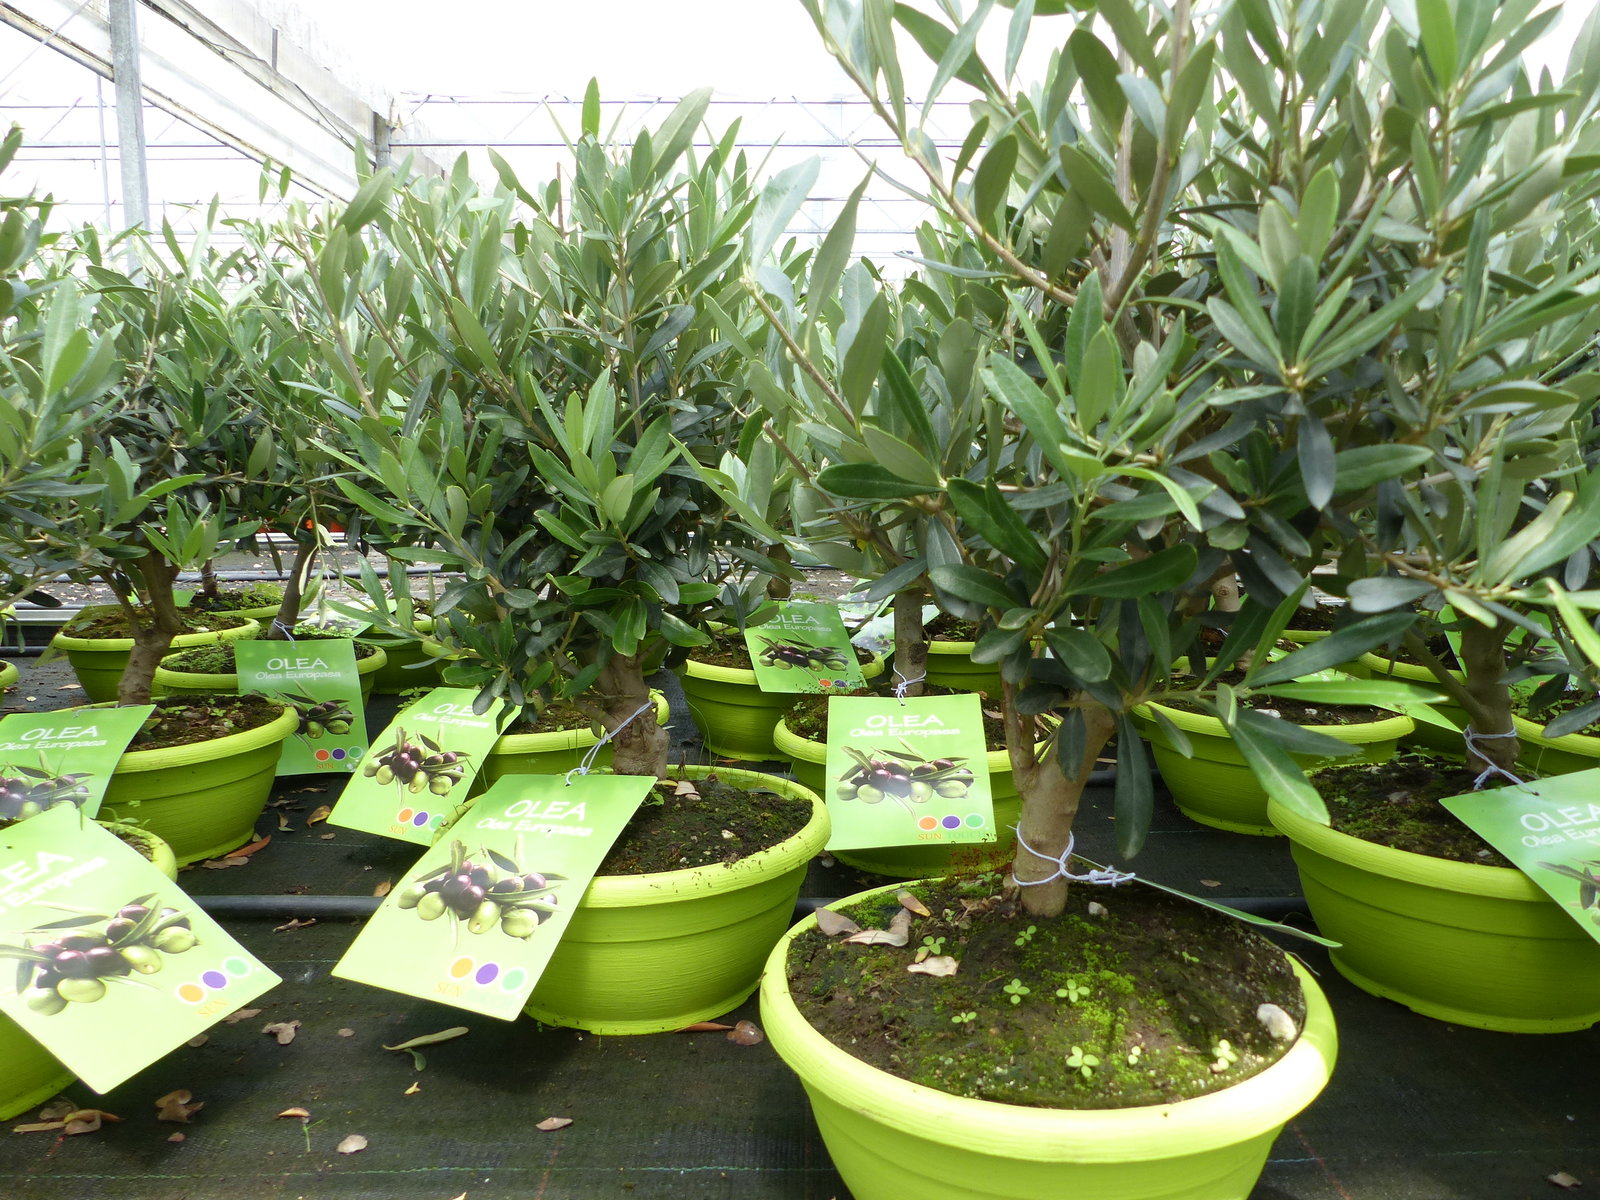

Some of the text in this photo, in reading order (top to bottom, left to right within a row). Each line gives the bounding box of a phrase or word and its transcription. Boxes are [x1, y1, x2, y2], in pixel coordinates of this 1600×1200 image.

[267, 658, 328, 670] OLEA
[255, 671, 282, 680] Olea
[433, 703, 487, 718] OLE
[865, 714, 944, 728] OLEA
[21, 726, 98, 740] OLEA
[849, 728, 883, 737] Olea
[504, 800, 587, 821] OLEA
[918, 832, 942, 841] SUN
[1521, 834, 1566, 848] Olea
